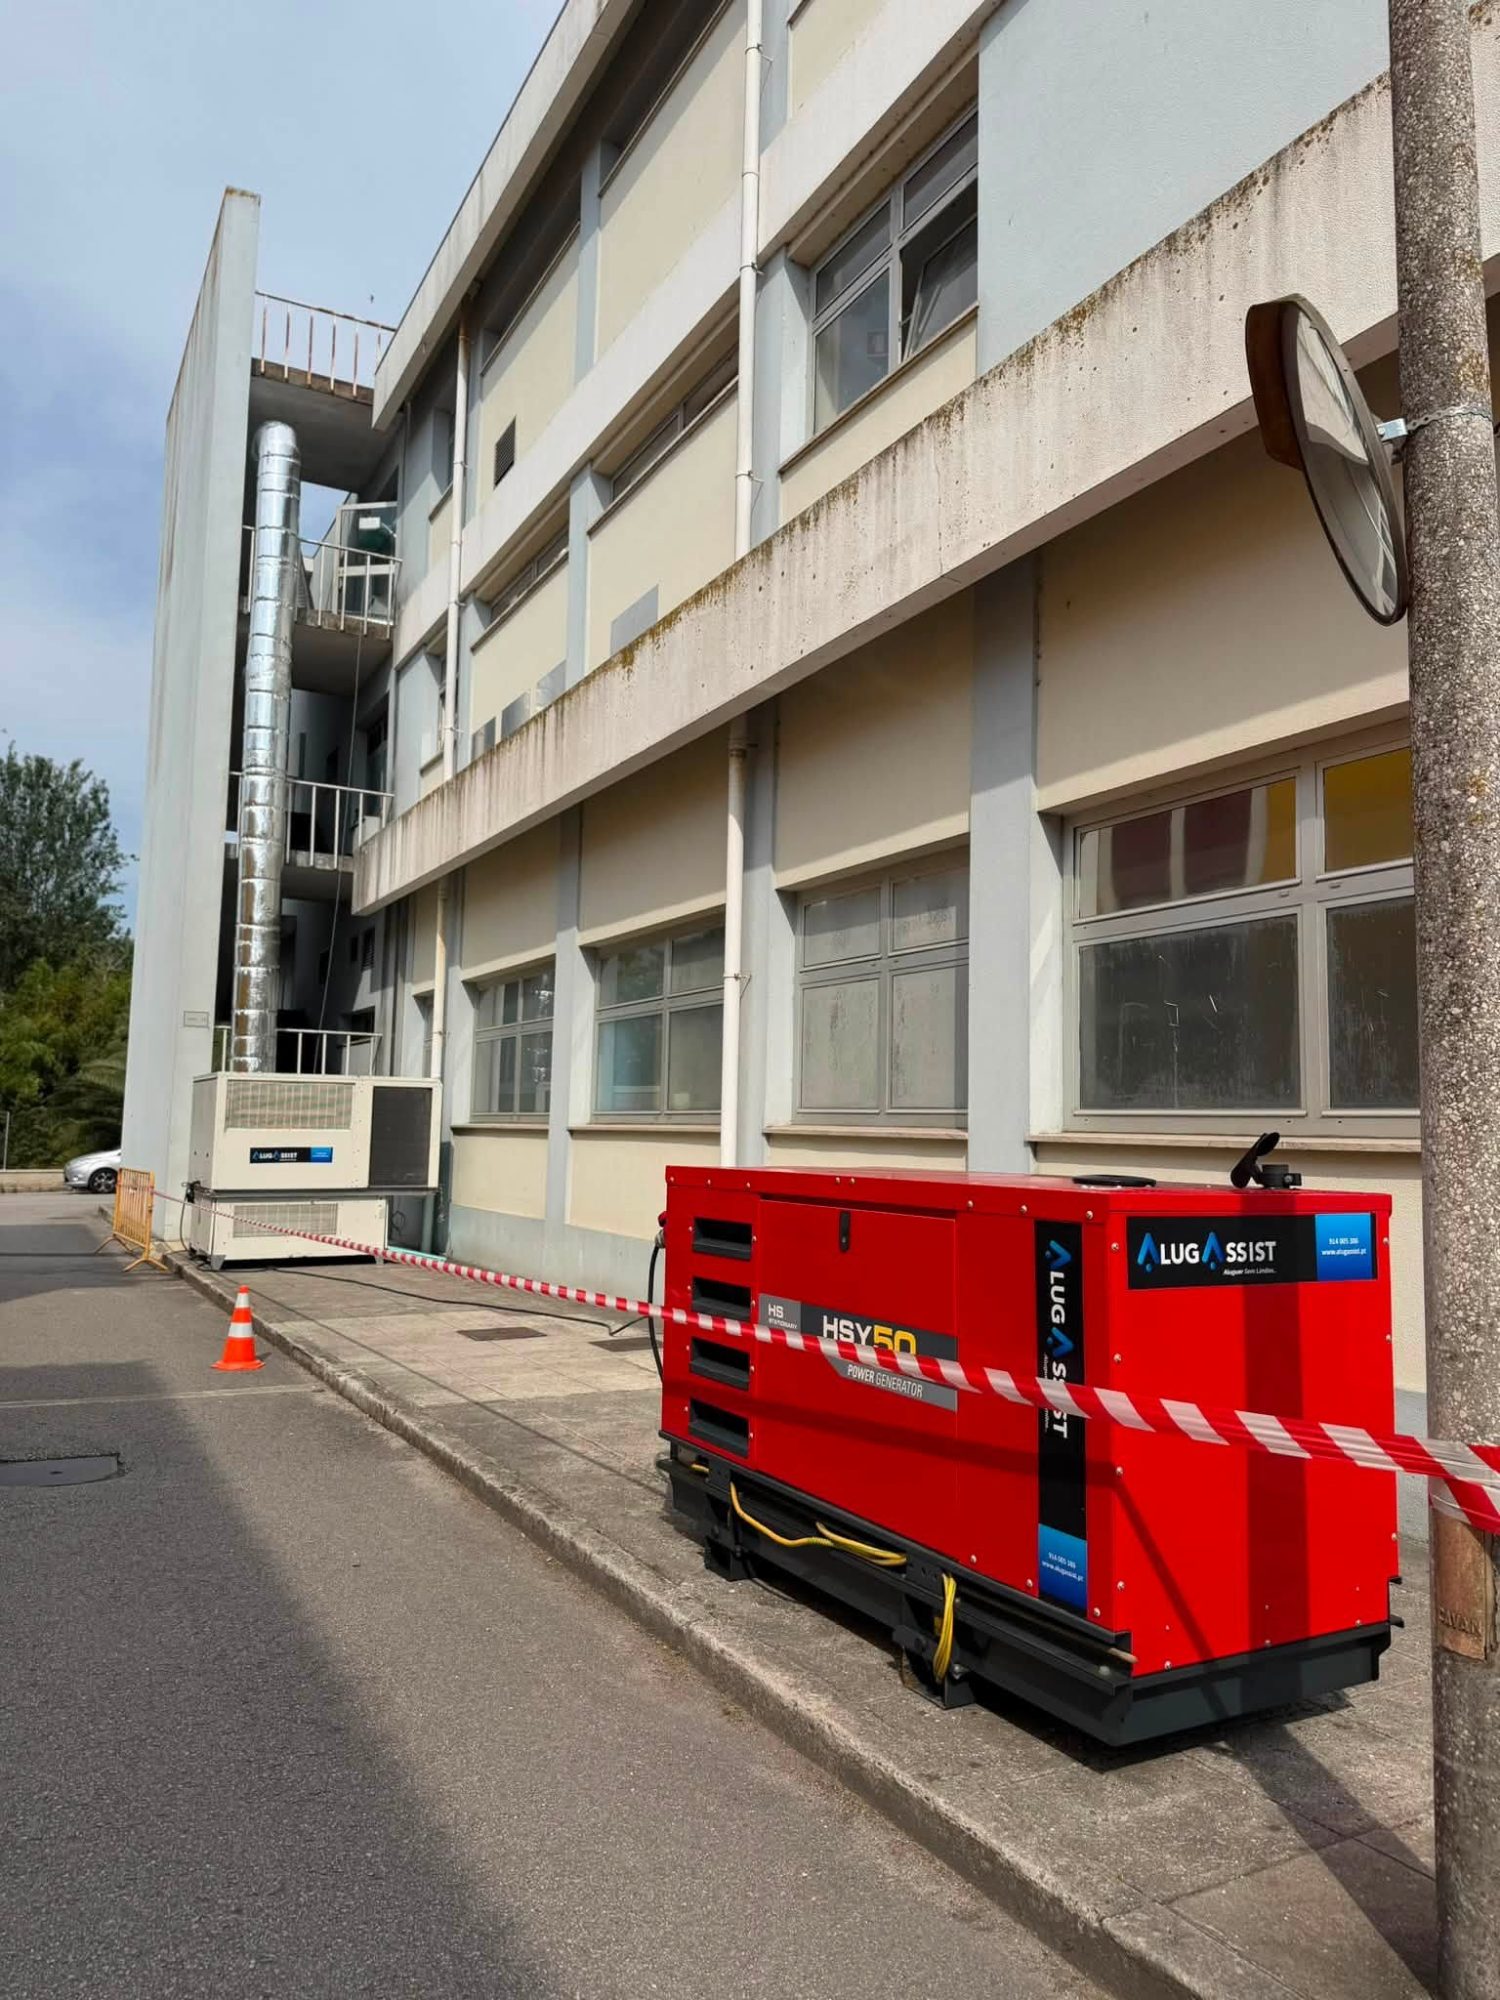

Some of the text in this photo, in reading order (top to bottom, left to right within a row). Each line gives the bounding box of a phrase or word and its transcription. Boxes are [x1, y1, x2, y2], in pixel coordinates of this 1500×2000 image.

[1137, 1231, 1277, 1272] ALUGASSIST
[768, 1303, 784, 1319] HS
[847, 1363, 923, 1399] POWER GENERATOR
